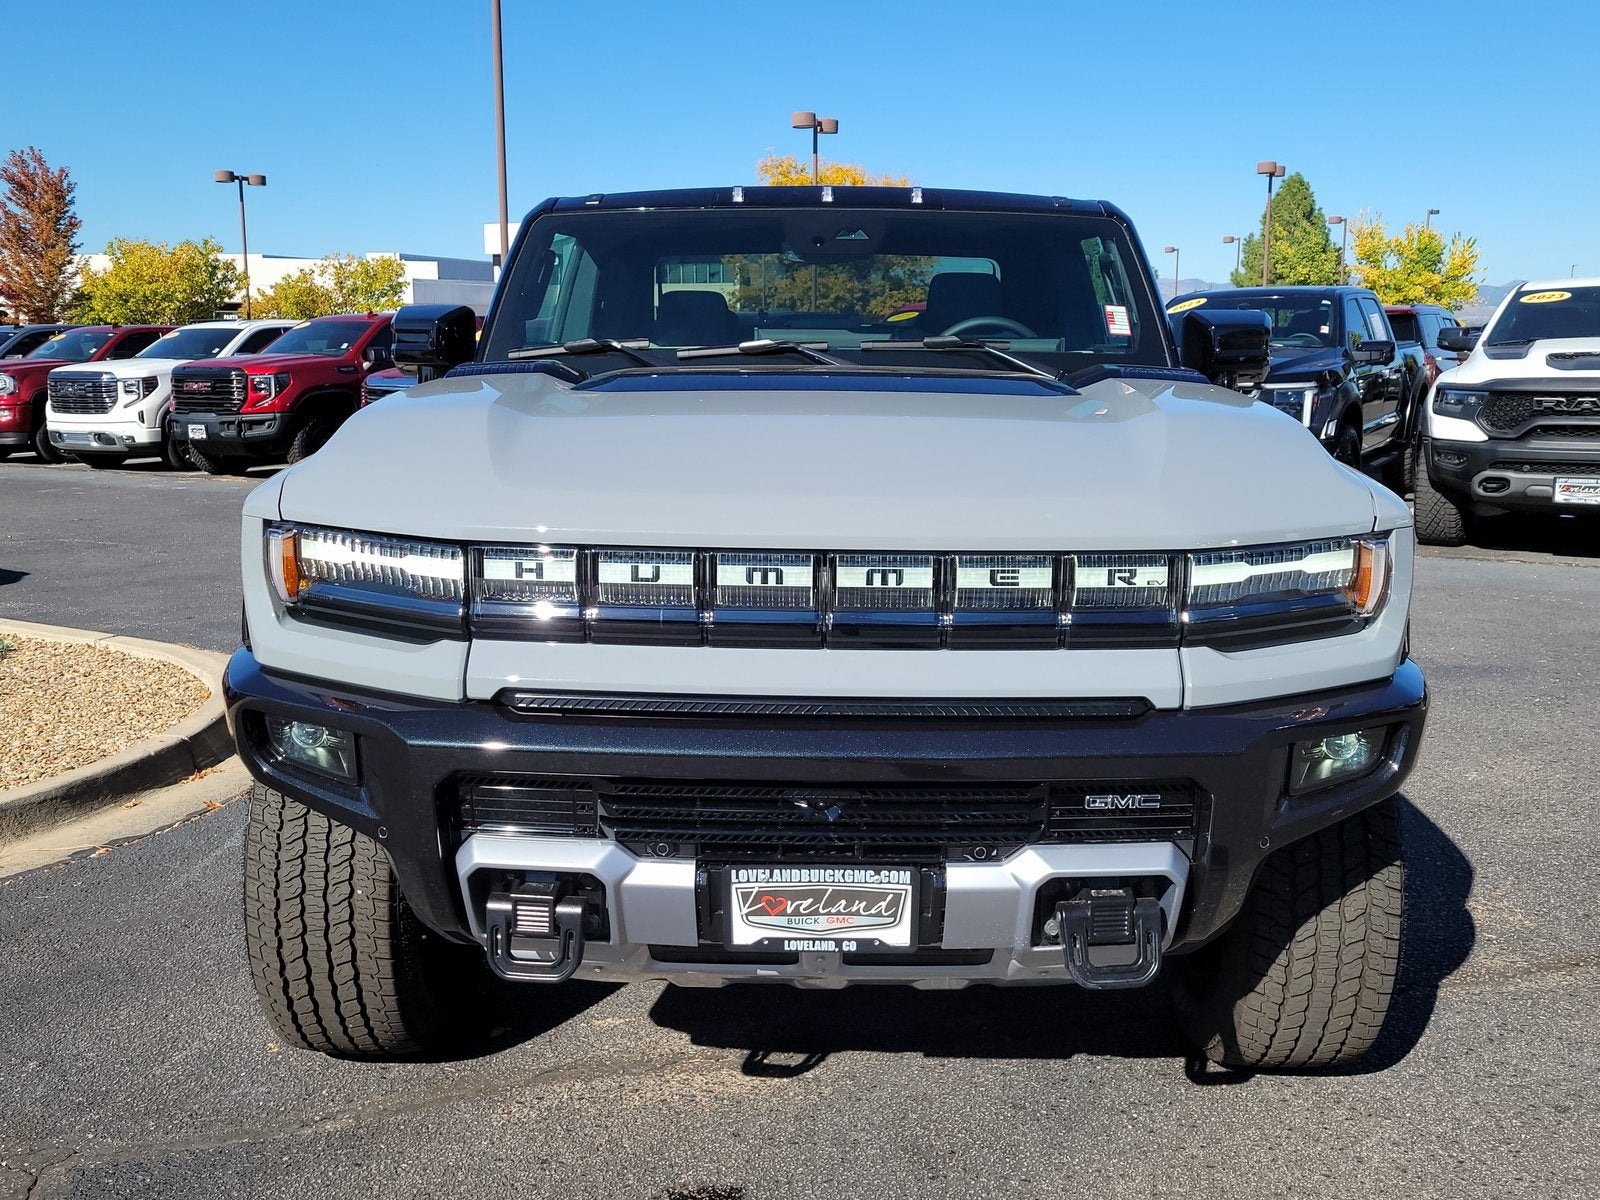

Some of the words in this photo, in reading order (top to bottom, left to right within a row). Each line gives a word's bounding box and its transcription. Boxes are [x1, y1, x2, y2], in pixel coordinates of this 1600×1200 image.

[183, 382, 212, 391] GMC
[1085, 794, 1160, 809] GMC
[731, 869, 911, 884] LOVELANDBUICKGMCCOM
[787, 917, 820, 925] BUICK
[826, 916, 855, 924] GMC
[784, 940, 839, 952] LOVELAND,
[842, 940, 857, 951] CO
